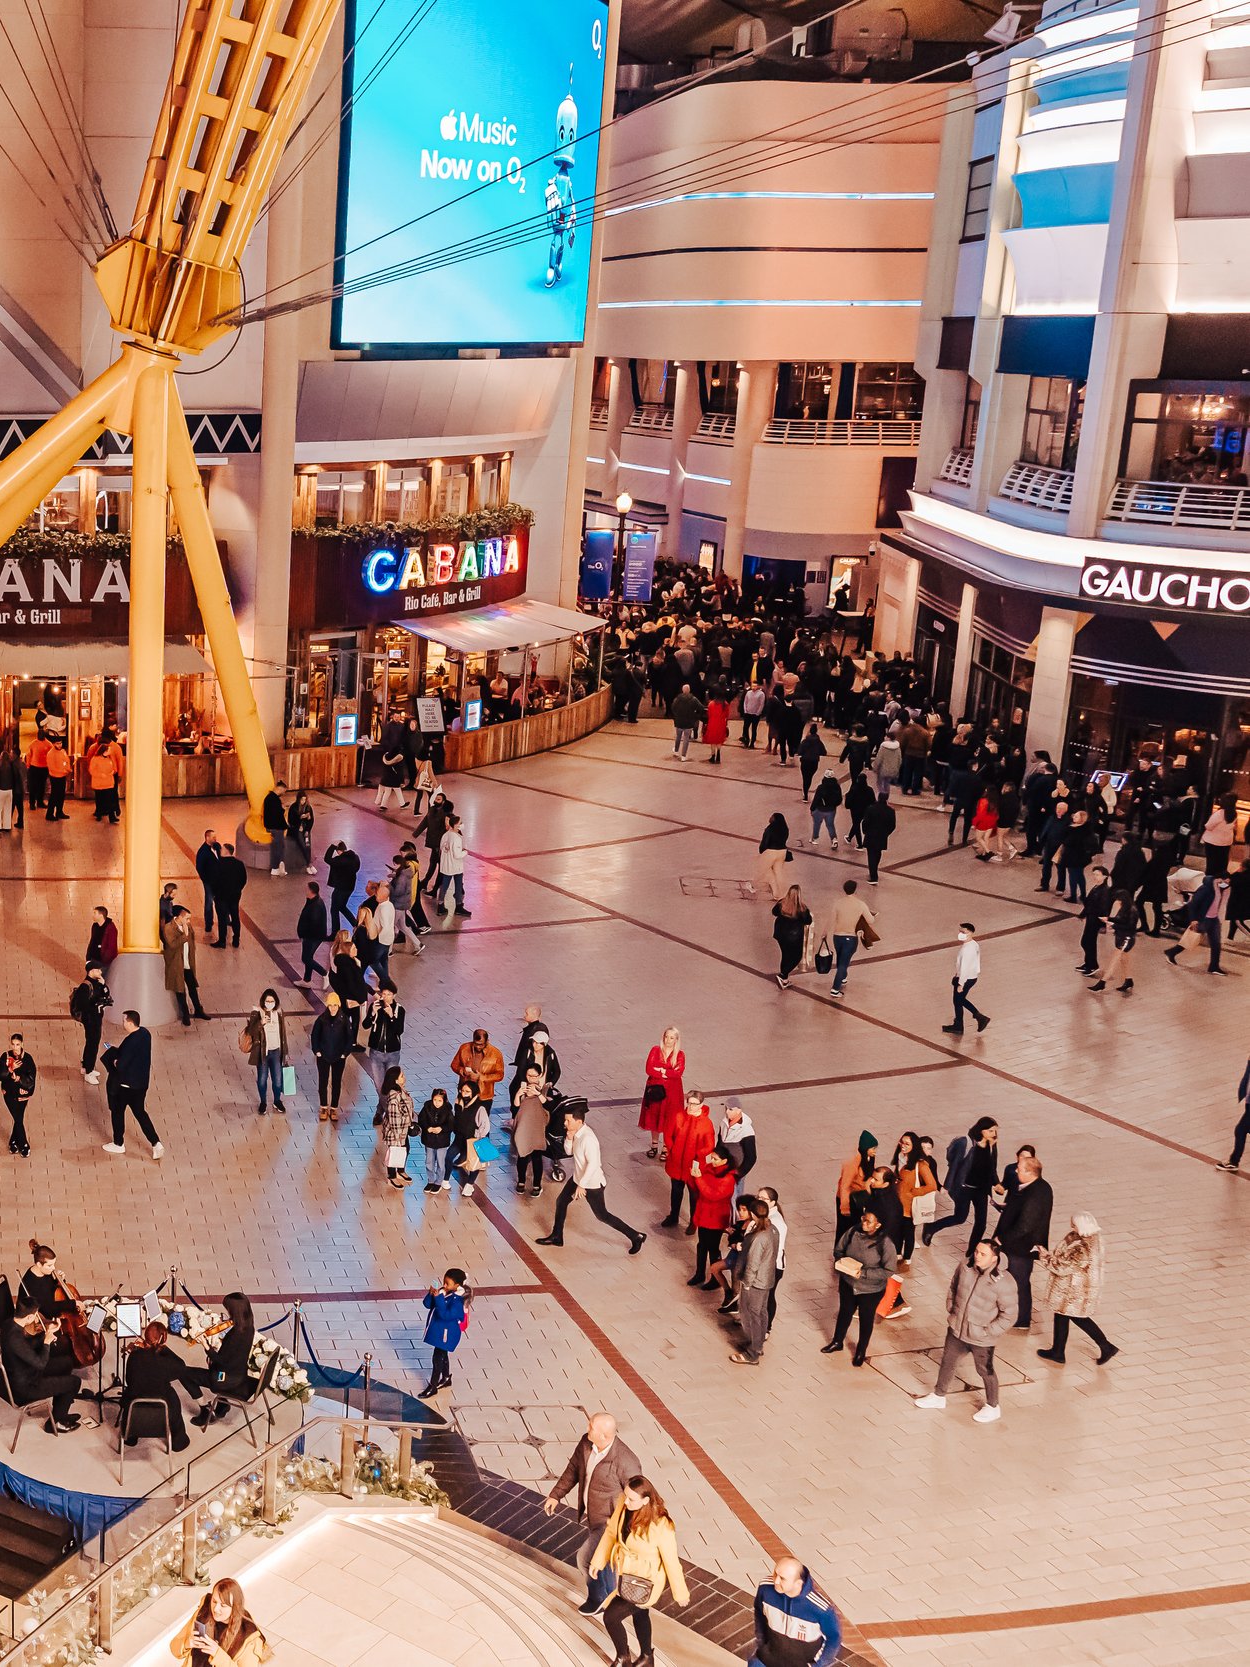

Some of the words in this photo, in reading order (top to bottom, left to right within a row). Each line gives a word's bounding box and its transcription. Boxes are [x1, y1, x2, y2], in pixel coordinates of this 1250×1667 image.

[592, 19, 602, 60] O2
[458, 111, 517, 147] Music
[420, 149, 473, 182] Now
[476, 156, 502, 183] on
[506, 156, 526, 194] O2
[361, 534, 520, 593] CABANA
[404, 595, 419, 611] Rio
[420, 592, 441, 608] Café,
[442, 590, 458, 606] Bar
[458, 589, 465, 603] &
[465, 585, 481, 602] Grill
[1081, 564, 1250, 611] GAUCHO
[14, 609, 27, 625] &
[30, 609, 61, 625] Grill
